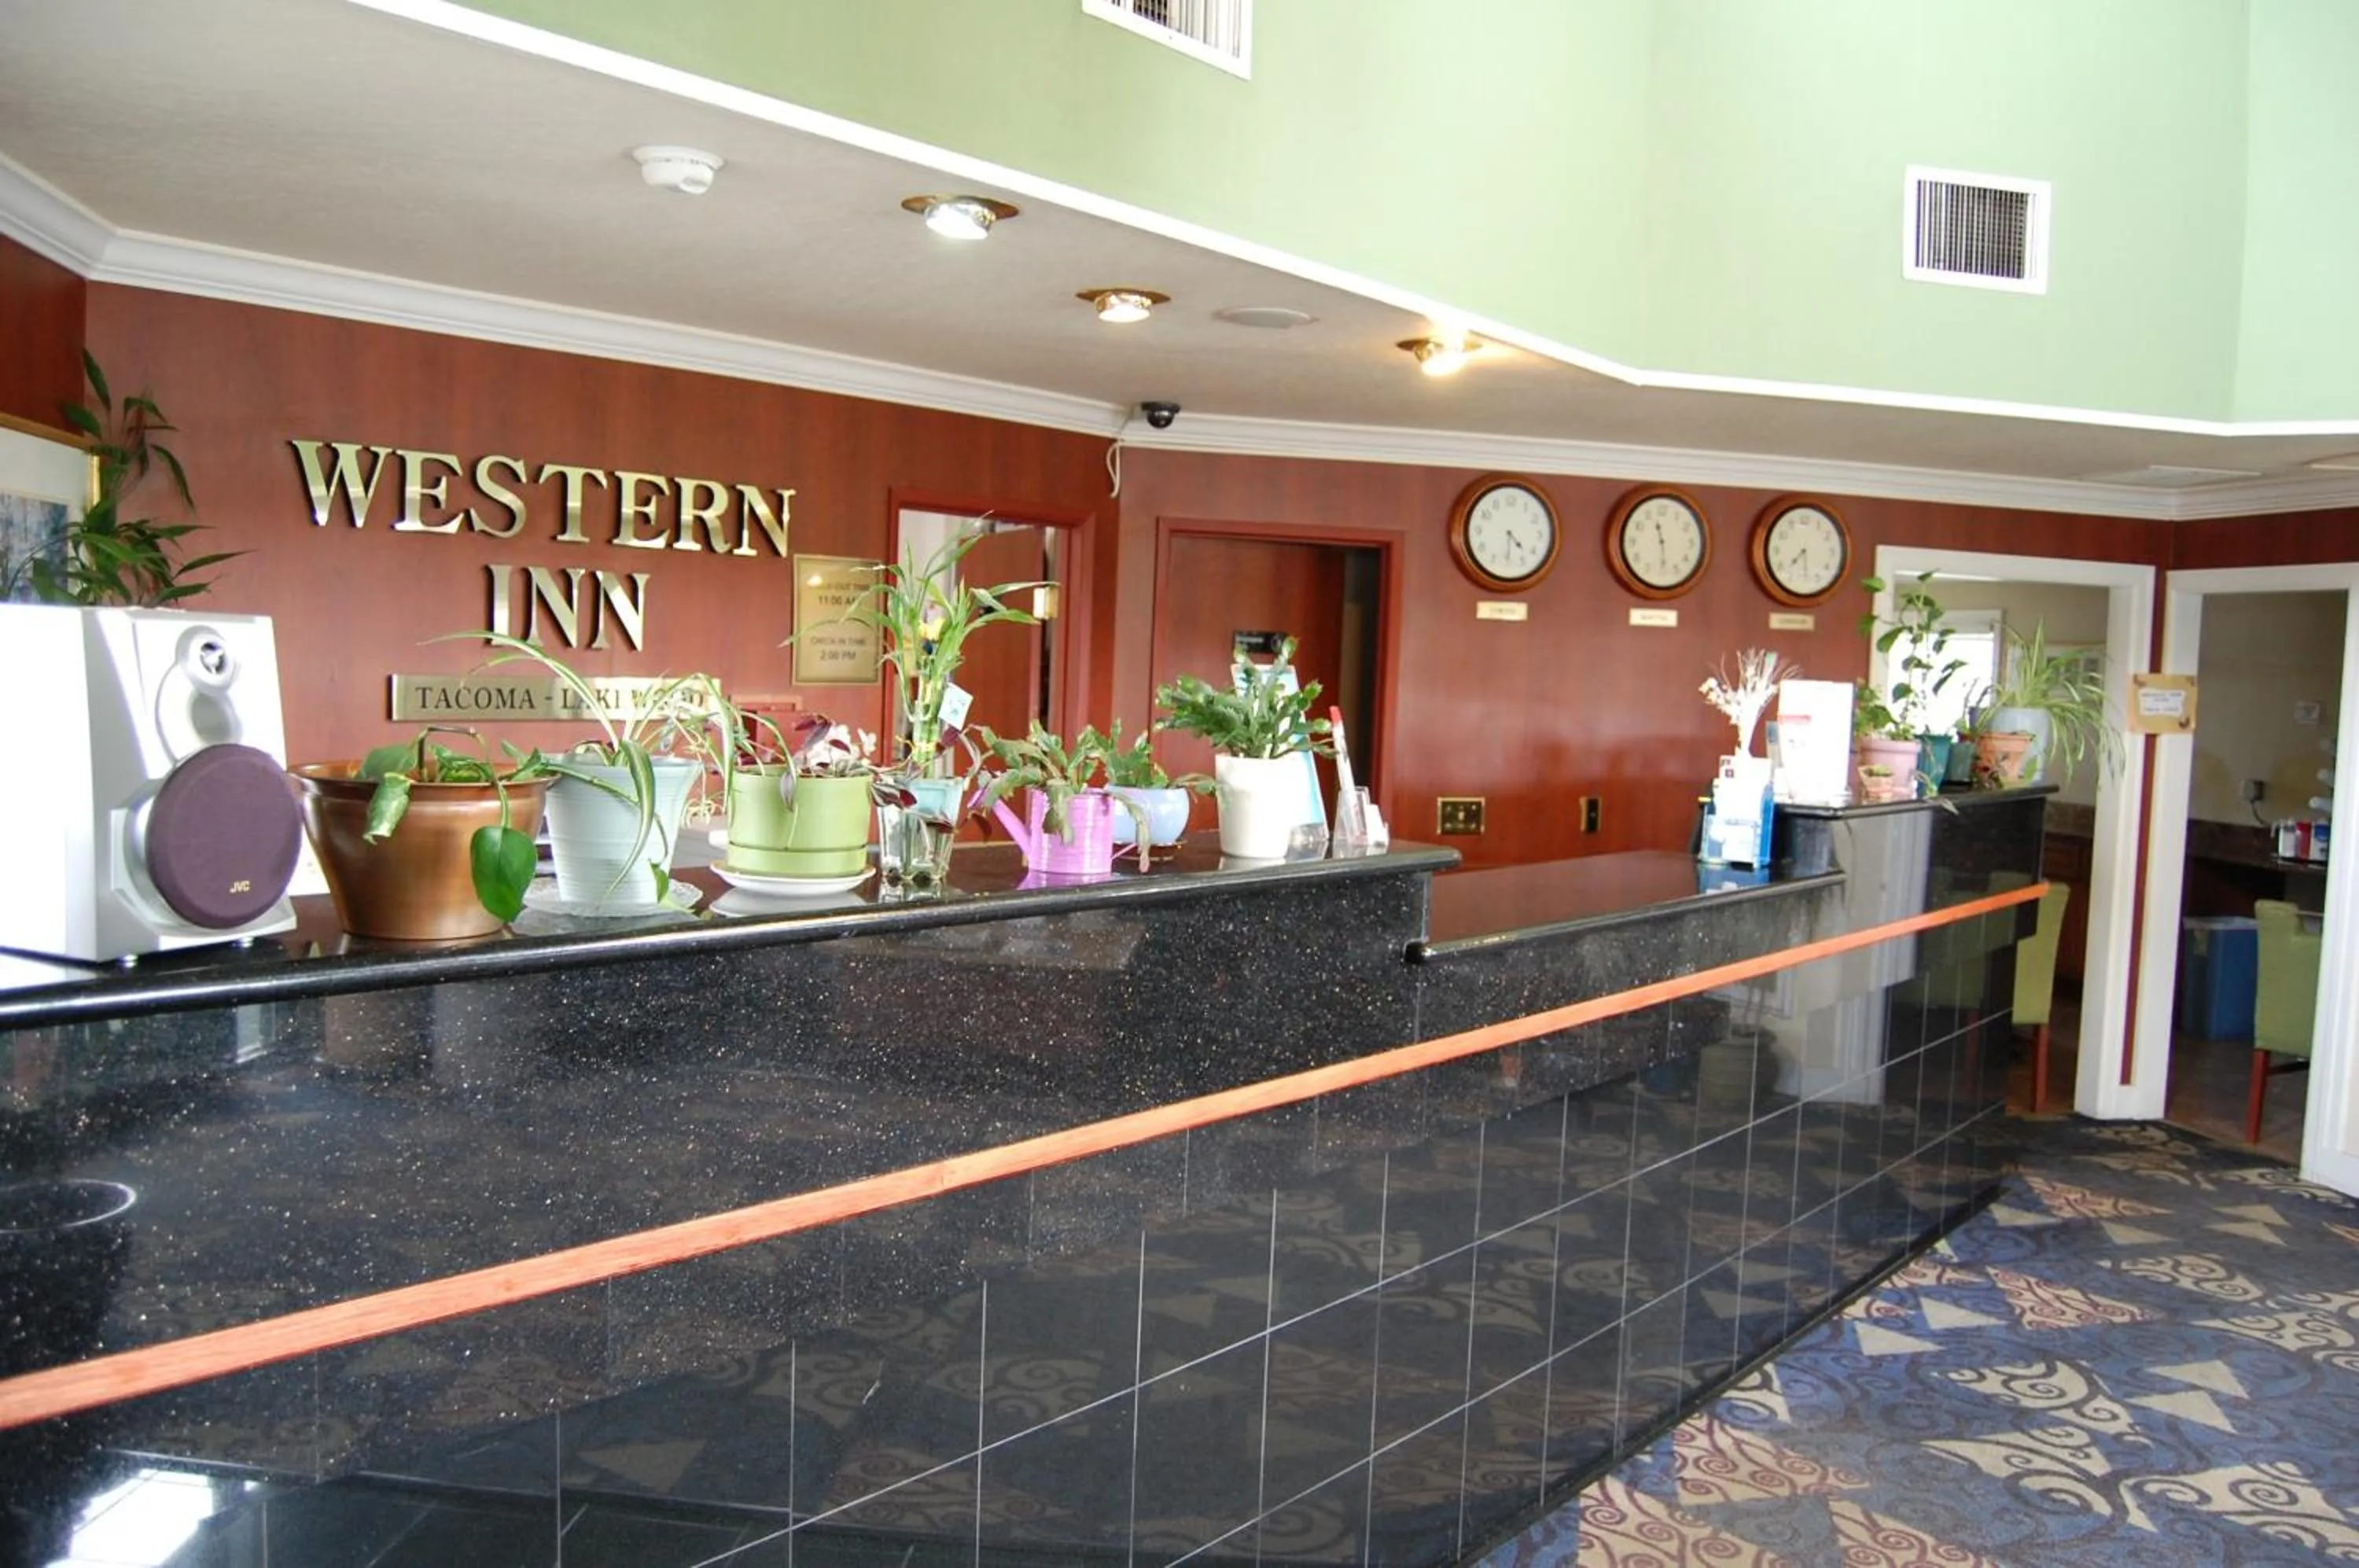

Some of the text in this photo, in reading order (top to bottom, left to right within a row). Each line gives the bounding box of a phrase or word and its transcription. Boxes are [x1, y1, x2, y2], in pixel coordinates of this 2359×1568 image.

[290, 440, 796, 558] WESTERN
[487, 564, 651, 653] INN
[841, 651, 856, 661] PM
[414, 686, 537, 709] TACOMA
[229, 880, 251, 893] JVC
